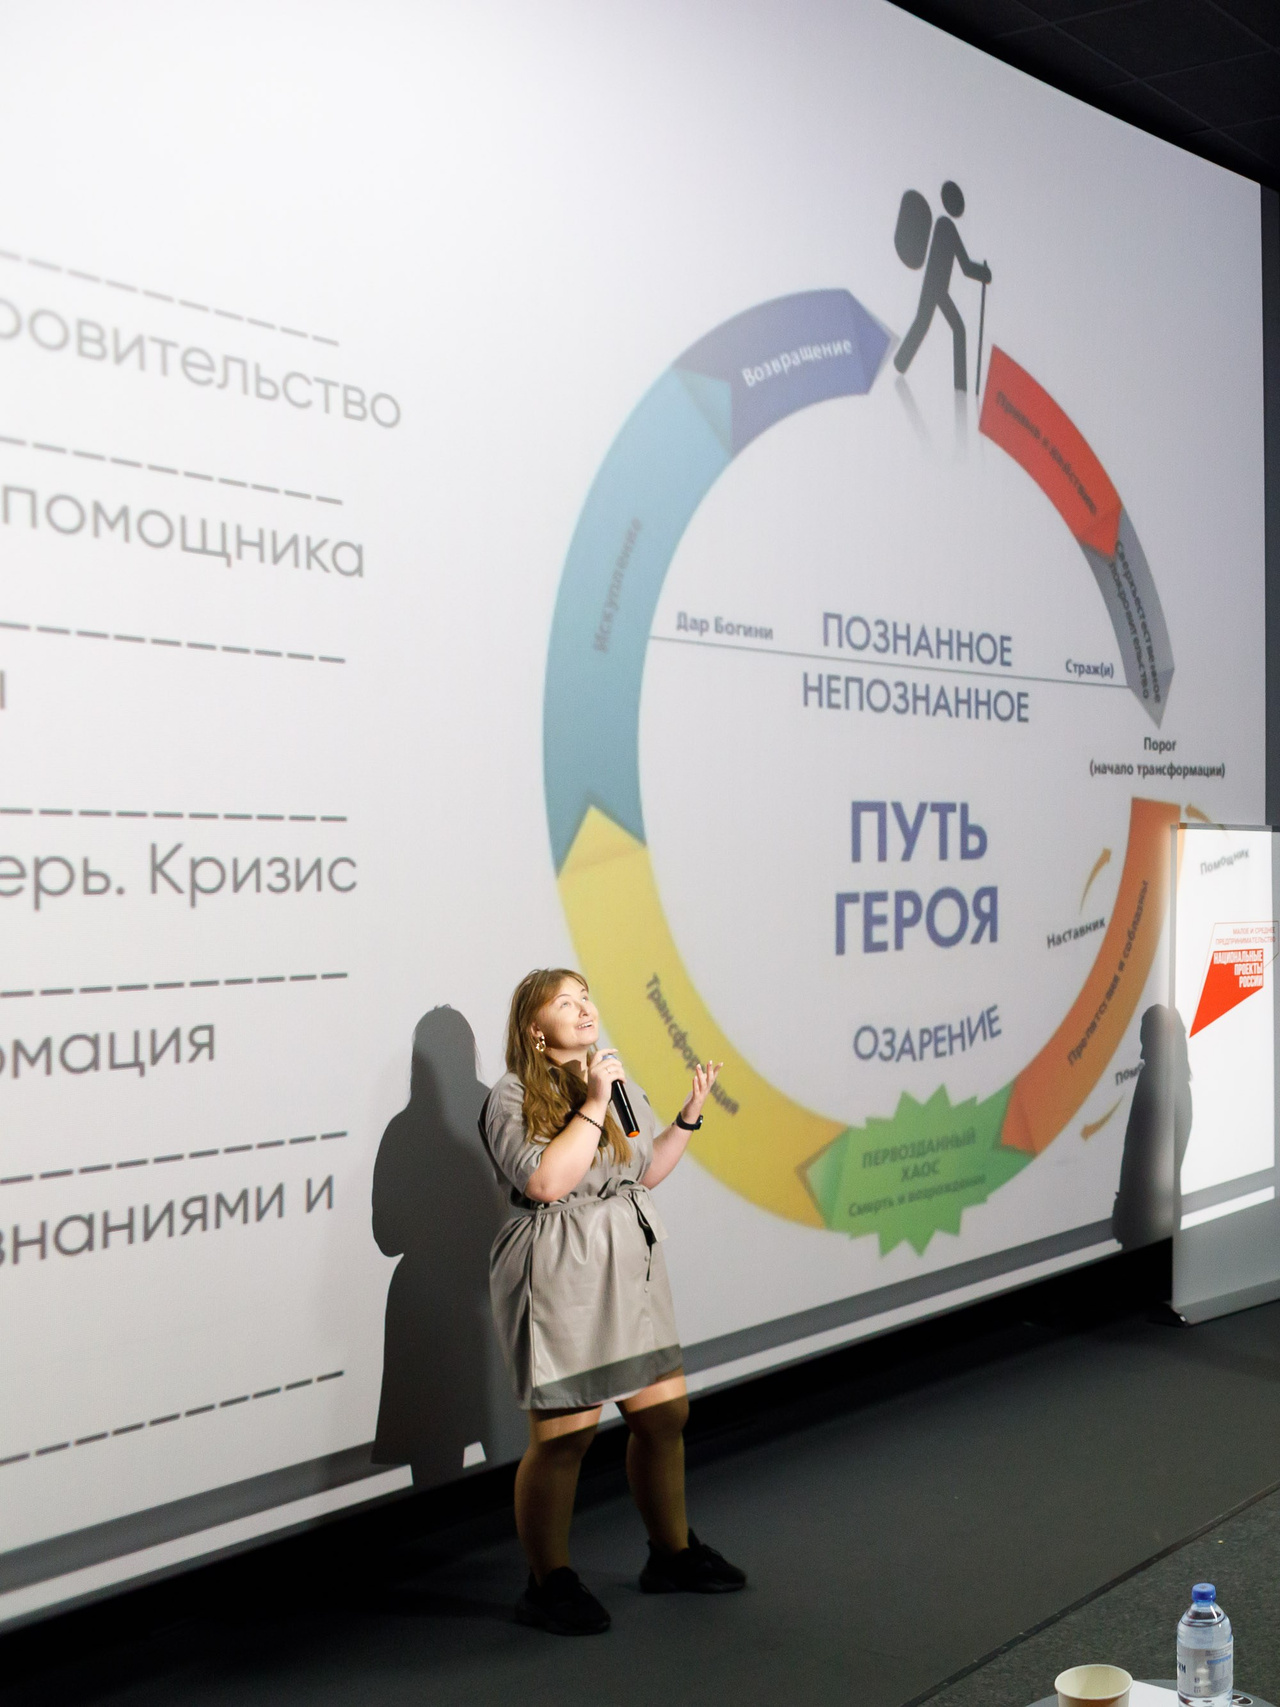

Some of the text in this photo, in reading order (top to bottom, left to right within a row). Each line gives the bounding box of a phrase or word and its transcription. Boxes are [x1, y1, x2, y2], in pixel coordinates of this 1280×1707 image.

[742, 339, 853, 388] Возвращение
[2, 484, 365, 579] помощника
[676, 610, 774, 641] Дар Богини
[822, 612, 1013, 667] ПОЗНАННОЕ
[1065, 658, 1116, 680] Страж(и)
[802, 672, 1030, 724] НЕПОЗНАННОЕ
[1143, 736, 1177, 755] Порог
[1089, 760, 1226, 780] (начало трансформации)
[849, 799, 990, 865] ПУТЬ
[148, 841, 358, 909] Кризис
[1199, 848, 1251, 875] Помощник
[834, 886, 999, 956] ГЕРОЯ
[1047, 917, 1106, 950] Наставник
[1213, 950, 1264, 965] НАЦИОНАЛЬНЫЕ
[1234, 963, 1264, 976] ПРОЕКТЫ
[1239, 975, 1264, 988] РОССИИ
[0, 1022, 216, 1079] мация
[852, 1005, 1003, 1063] ОЗАРЕНИЕ
[861, 1126, 977, 1169] ПЕРВОЗДАННЫЙ
[901, 1159, 941, 1182] ХАОС
[0, 1173, 335, 1267] наниями и
